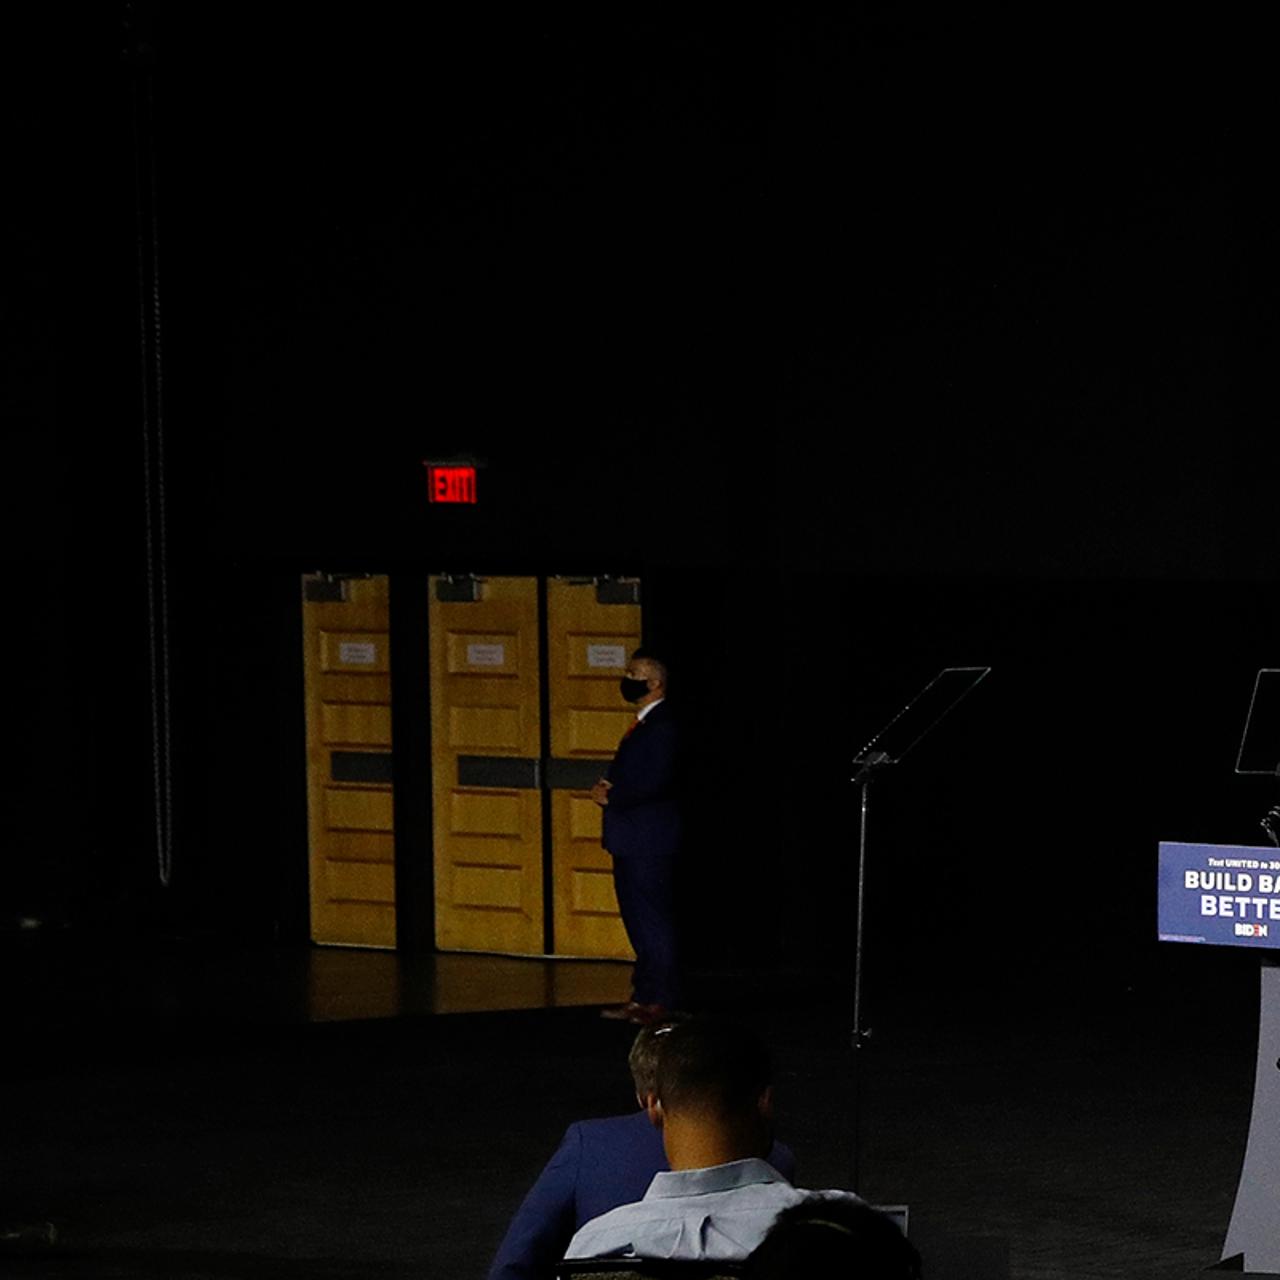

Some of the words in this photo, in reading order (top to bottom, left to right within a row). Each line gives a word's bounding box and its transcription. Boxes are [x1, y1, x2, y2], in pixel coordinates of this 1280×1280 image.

[434, 467, 475, 503] EXIT
[1208, 858, 1224, 867] Text
[1225, 859, 1259, 869] UNITED
[1261, 861, 1268, 869] to
[1185, 870, 1252, 891] BUILD
[1235, 923, 1268, 937] BIDEN
